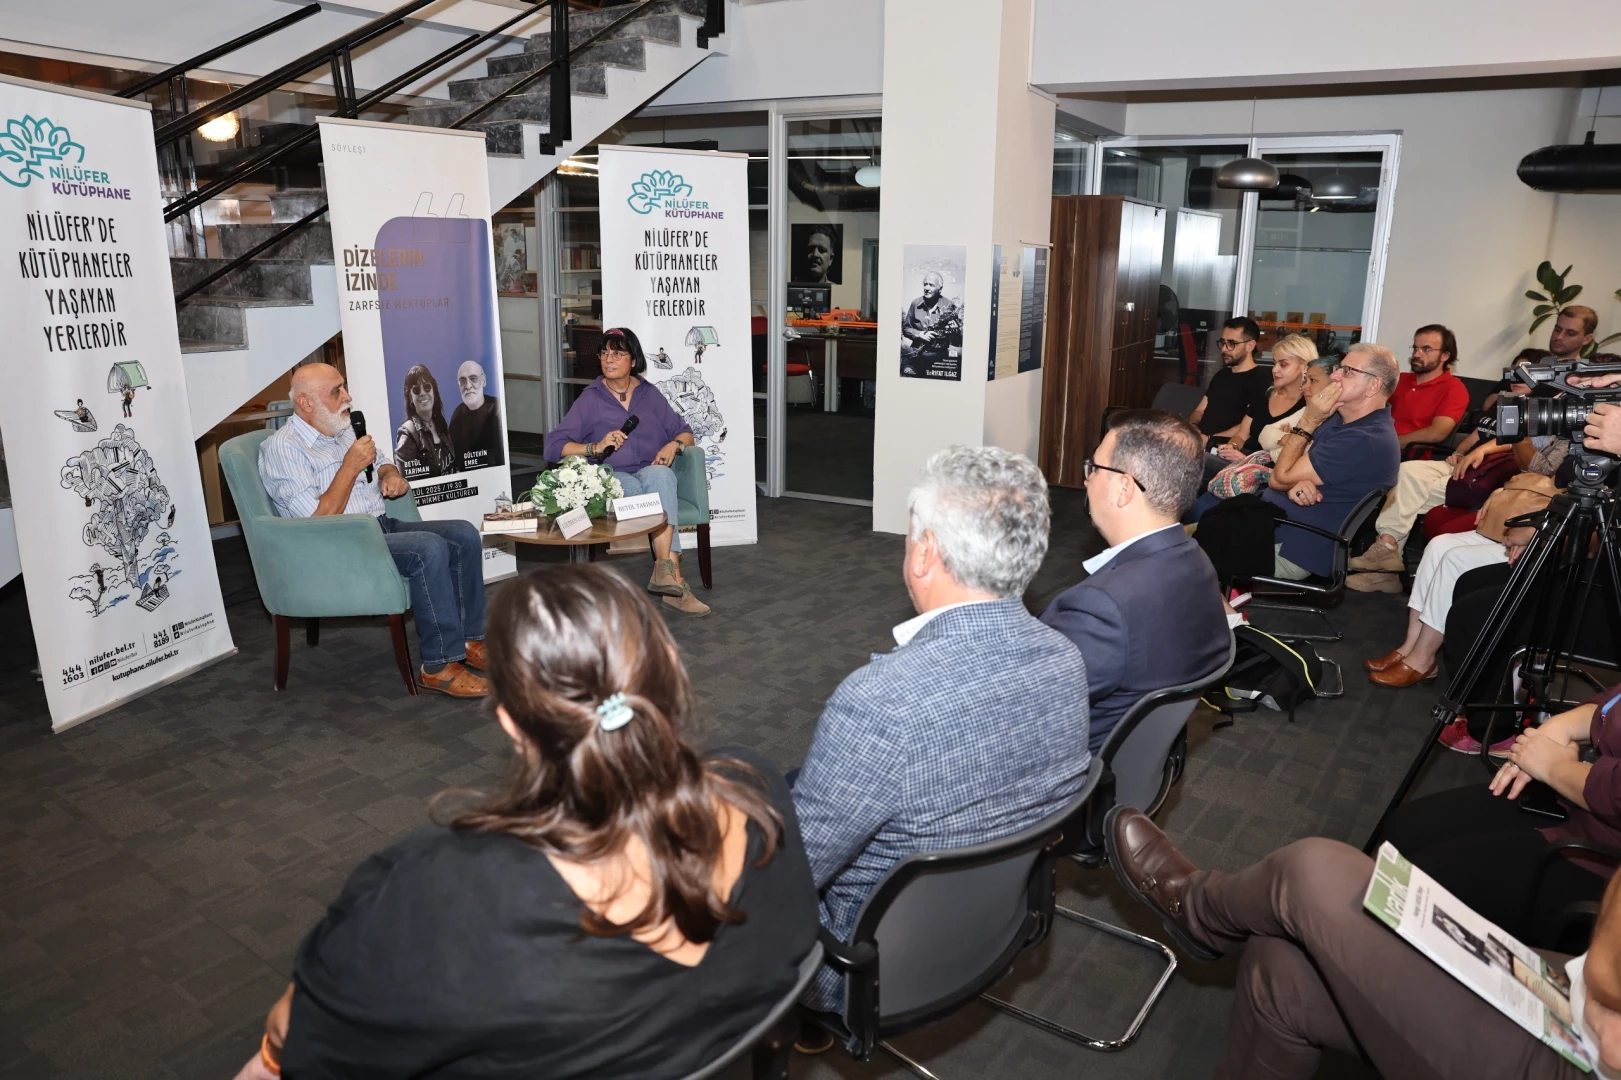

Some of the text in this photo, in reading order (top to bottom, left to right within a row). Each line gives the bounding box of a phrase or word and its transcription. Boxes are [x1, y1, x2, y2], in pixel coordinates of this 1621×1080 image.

[331, 143, 366, 156] SÖYLEŞİ
[48, 164, 111, 185] NİLÜFER
[52, 180, 131, 200] KÜTÜPHANE
[665, 198, 710, 209] NİLÜFER
[665, 208, 724, 219] KÜTÜPHANE
[27, 210, 117, 243] NİLÜFER'DE
[644, 228, 709, 248] NİLÜFER'DE
[19, 248, 133, 279] KÜTÜPHANELER
[343, 244, 425, 267] DİZELERİN
[635, 251, 718, 271] KÜTÜPHANELER
[345, 268, 399, 292] İZİNDE
[650, 276, 700, 296] YAŞAYAN
[45, 287, 116, 319] YAŞAYAN
[349, 297, 449, 311] ZARFSIZ MEKTUPLAR
[646, 297, 706, 317] YERLERDİR
[43, 318, 128, 352] YERLERDİR
[404, 459, 421, 468] BETÜL
[463, 449, 488, 459] GÜLTEKİN
[464, 458, 478, 467] EMRE
[405, 466, 430, 475] TARIMAN
[422, 494, 444, 504] HİKMET
[153, 629, 168, 640] 441
[153, 636, 170, 649] 8189
[88, 641, 136, 666] nilufer.bel.tr
[62, 664, 82, 677] 444
[112, 649, 180, 682] kutuphane.nilufer.bel.tr
[62, 672, 85, 685] 1603
